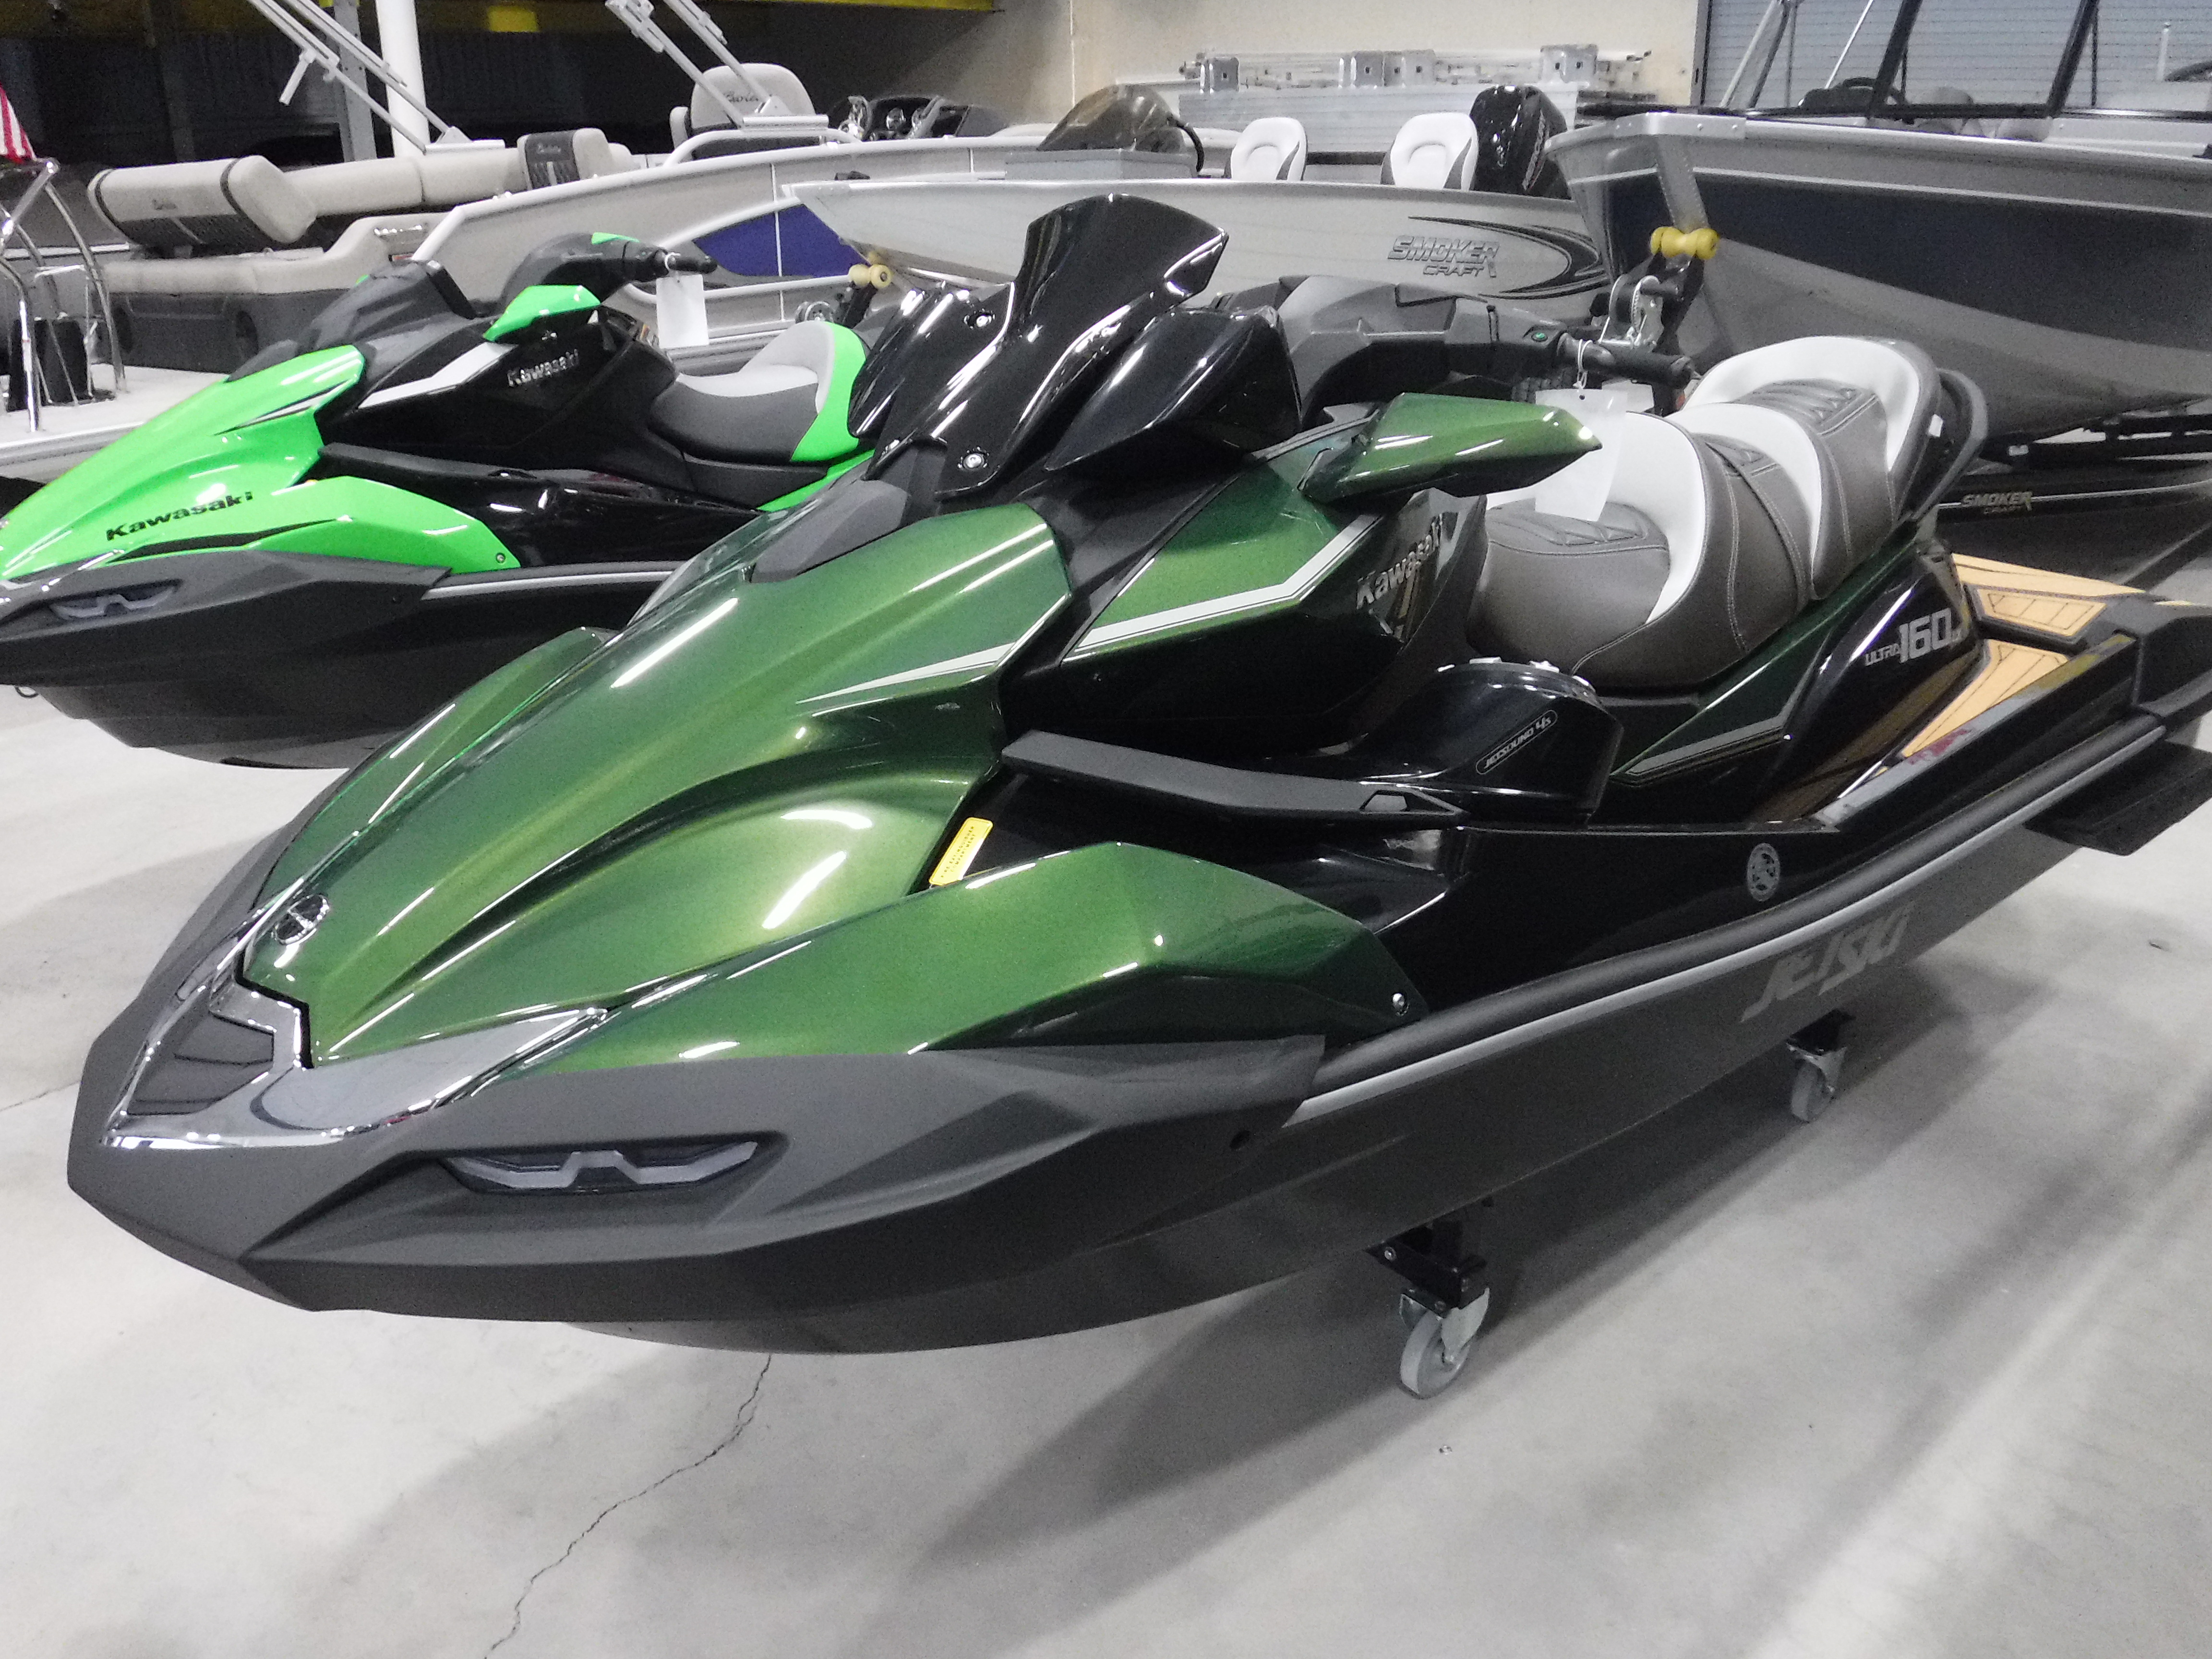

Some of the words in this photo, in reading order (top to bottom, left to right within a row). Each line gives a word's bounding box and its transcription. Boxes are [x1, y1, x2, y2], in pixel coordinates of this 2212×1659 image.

[1387, 235, 1500, 278] SMOKER
[1422, 264, 1485, 277] CRAFT
[507, 348, 579, 387] Kawasaki
[106, 491, 253, 541] Kawasaki
[1962, 491, 2033, 512] SMOKER
[1356, 513, 1443, 610] Kawasaki
[1865, 643, 1900, 667] ULTRA
[1899, 608, 1952, 664] 160
[1483, 727, 1534, 769] JETSOUND
